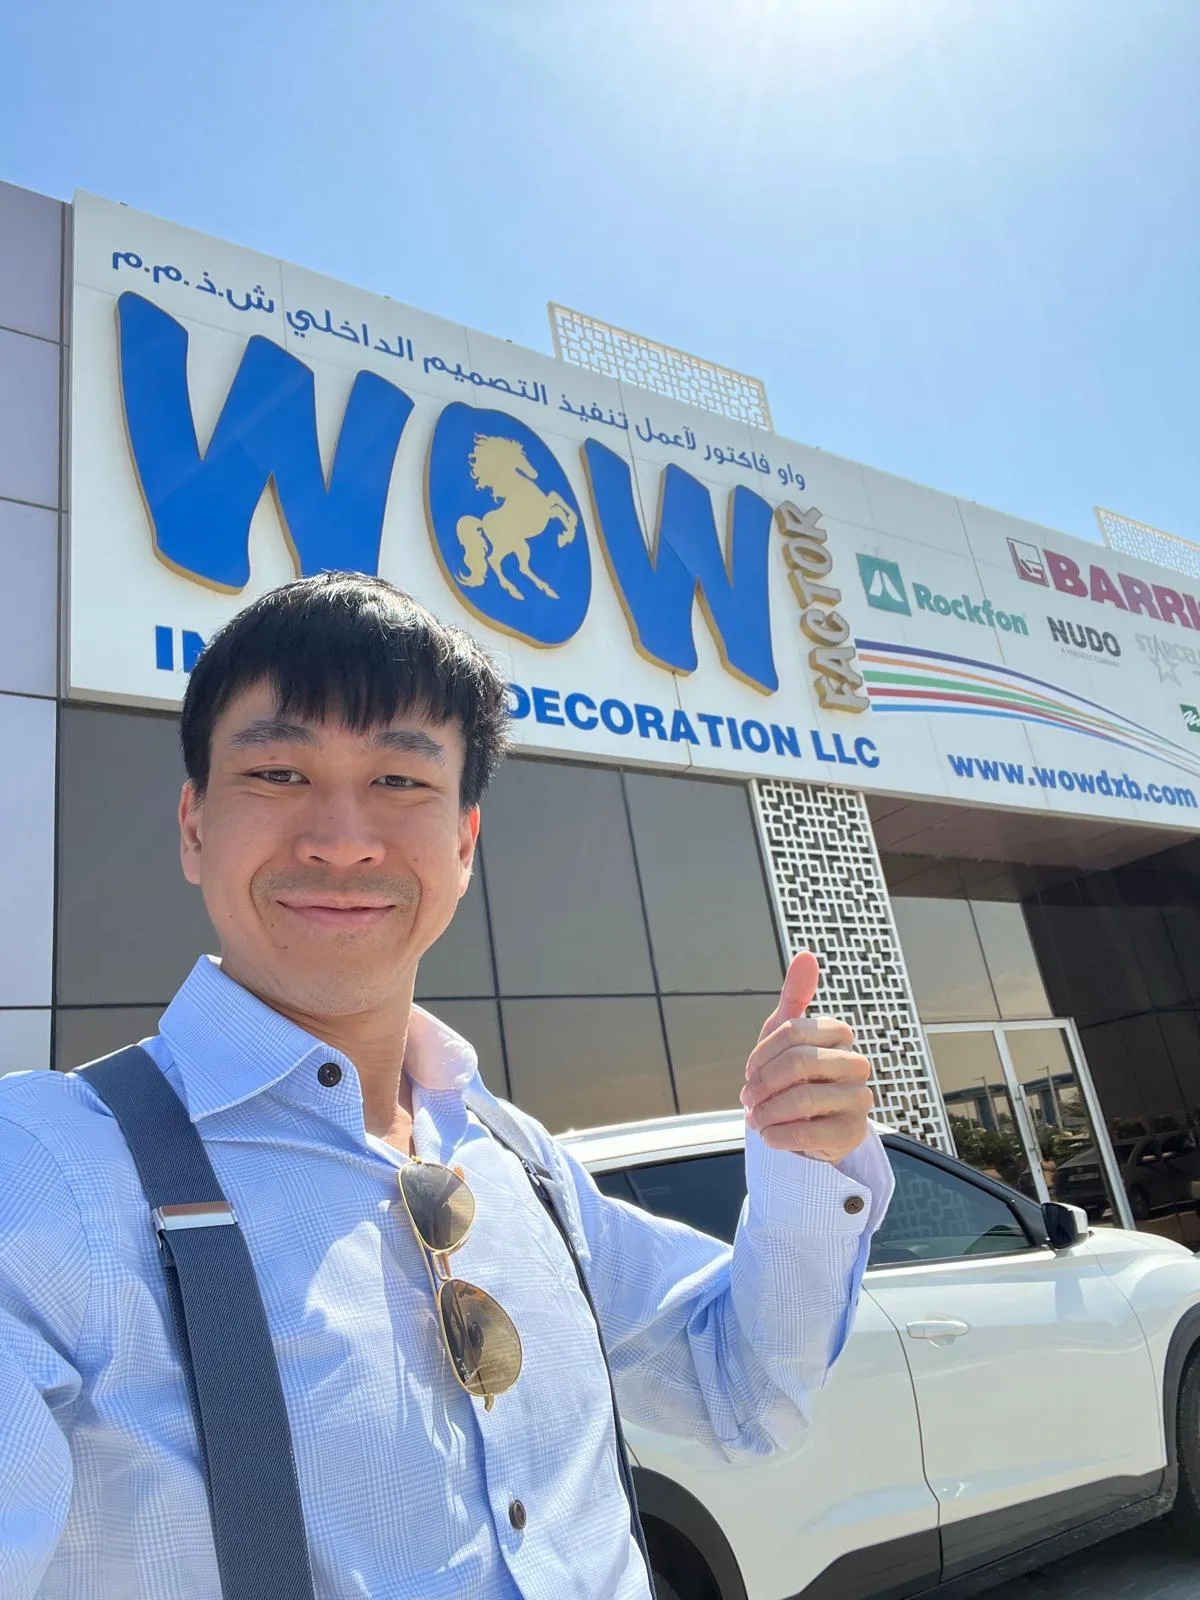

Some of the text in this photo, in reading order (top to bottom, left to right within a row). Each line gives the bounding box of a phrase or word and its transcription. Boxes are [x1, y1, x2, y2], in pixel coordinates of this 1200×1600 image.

[286, 309, 414, 362] الداخلي
[423, 356, 548, 405] التصميم
[558, 393, 629, 430] تنفيذ
[703, 444, 771, 475] فاكتور
[777, 463, 806, 491] واو
[116, 291, 779, 696] WOW
[776, 500, 871, 713] FACTOR
[911, 582, 1030, 637] Rockfon
[1043, 549, 1200, 631] BARRI
[1046, 615, 1121, 657] NUDO
[504, 681, 881, 769] DECORATION LLC
[946, 754, 1199, 809] www.wowdxb.com
